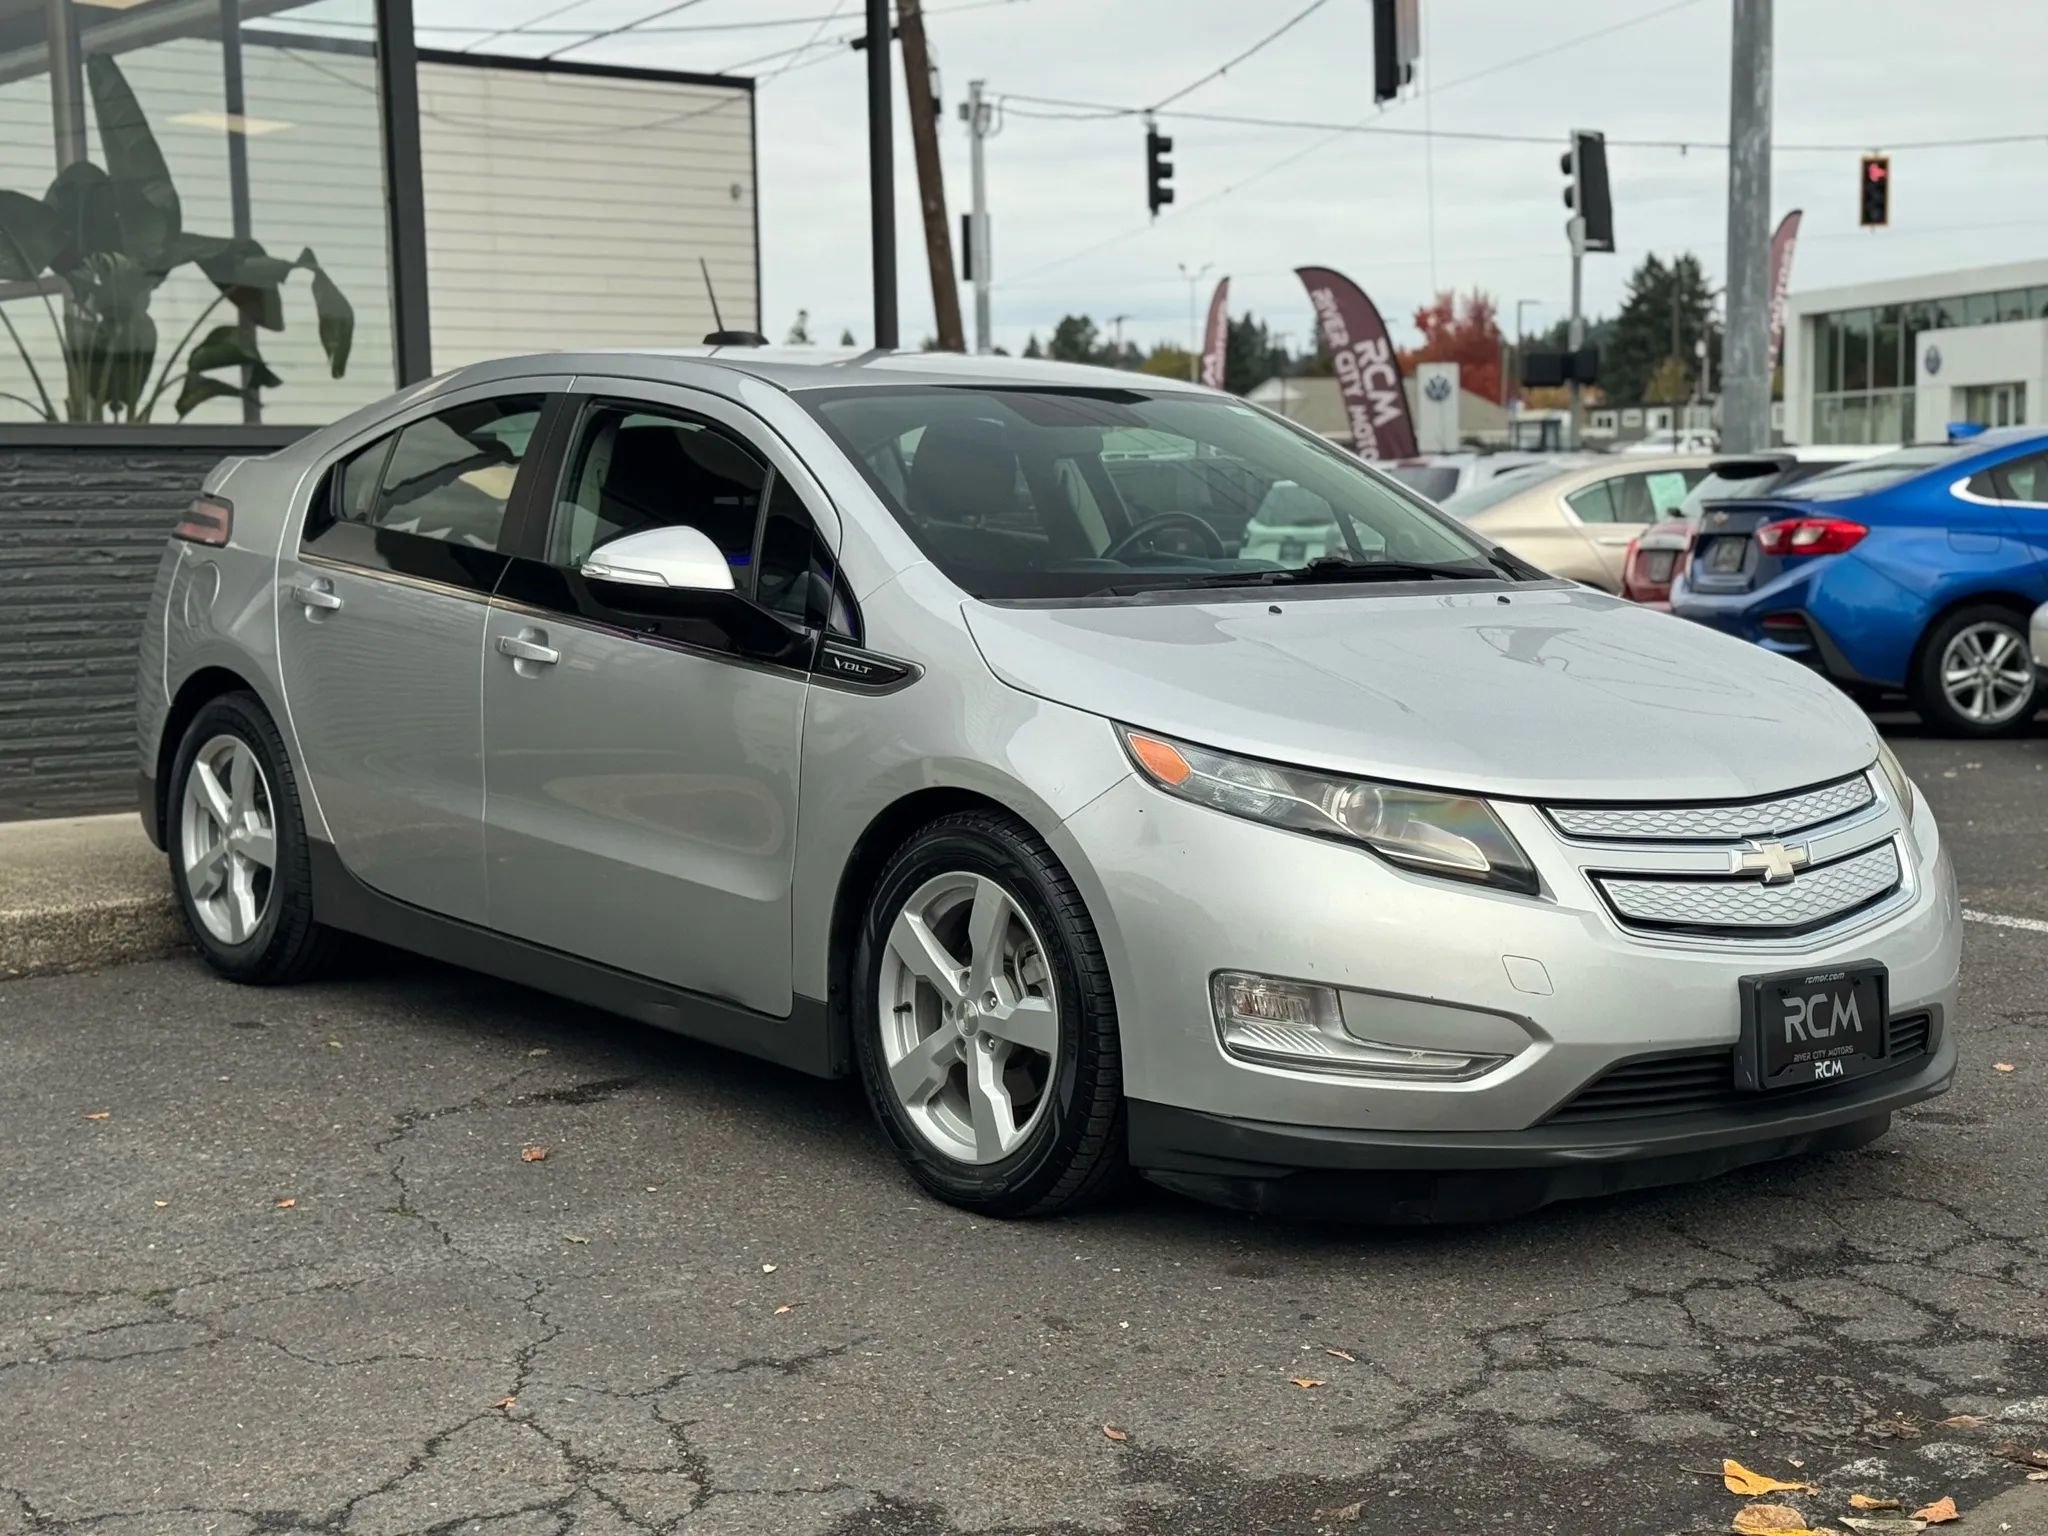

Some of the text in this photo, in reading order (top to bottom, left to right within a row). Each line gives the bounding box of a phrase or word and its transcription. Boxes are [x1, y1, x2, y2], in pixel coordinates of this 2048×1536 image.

[1311, 287, 1380, 462] RIVER CITY MOTO
[1353, 337, 1403, 428] RCM
[834, 656, 873, 674] VOLT
[1782, 989, 1863, 1044] RCM
[1793, 1045, 1854, 1062] RIVER CITY MOTORS
[1814, 1060, 1844, 1079] RCM
